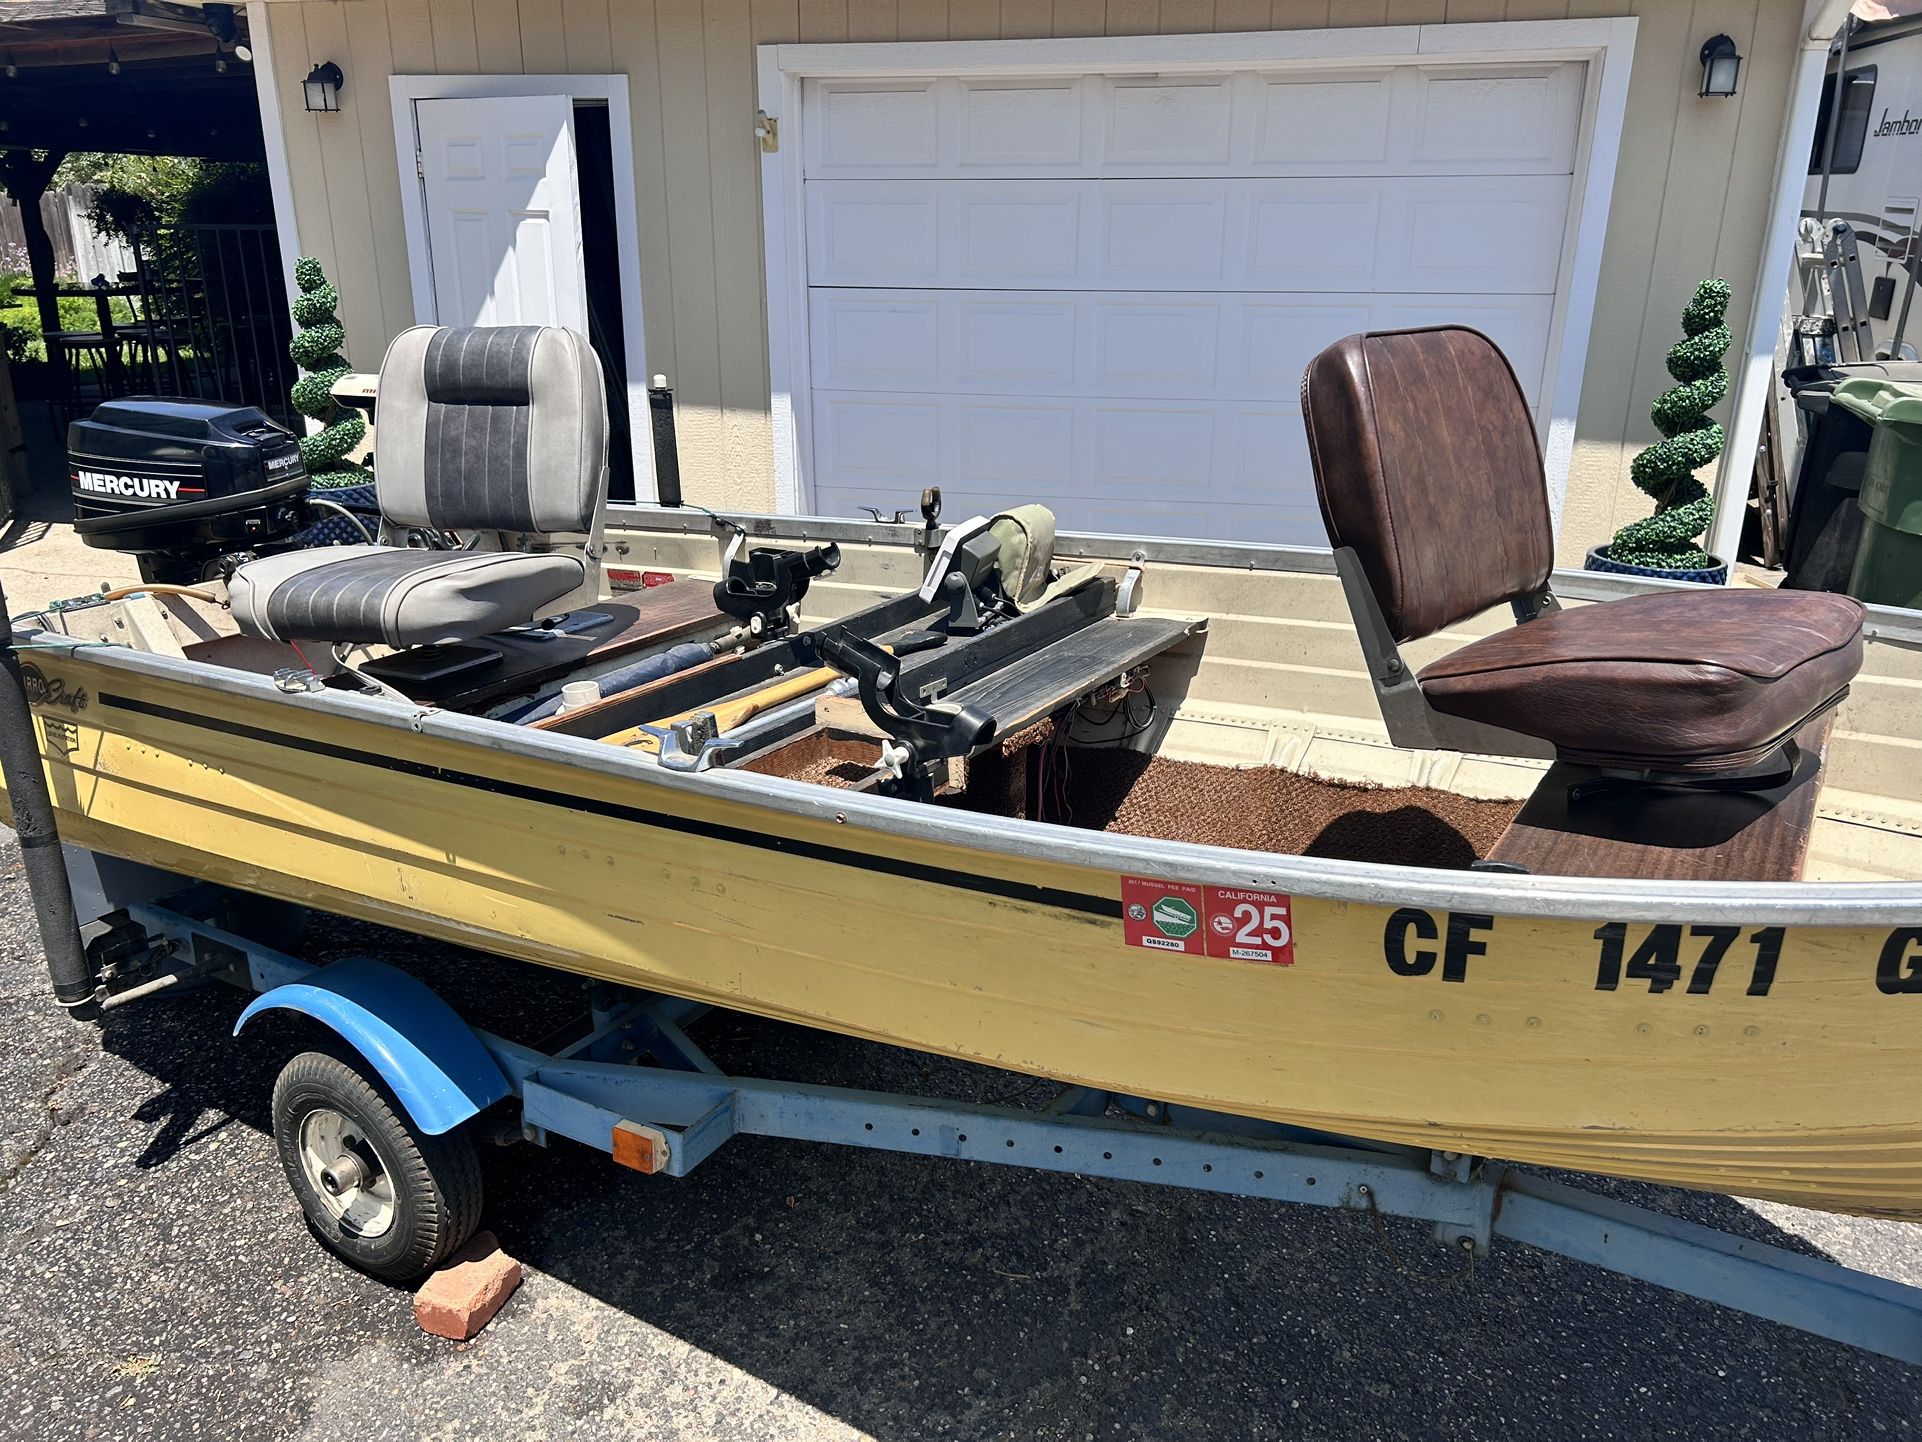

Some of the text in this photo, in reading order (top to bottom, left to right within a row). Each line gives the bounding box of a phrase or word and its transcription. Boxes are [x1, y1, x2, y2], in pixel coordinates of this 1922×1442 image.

[268, 453, 299, 470] MERCURY
[78, 470, 181, 499] MERCURY
[44, 679, 88, 713] Craft
[1141, 881, 1165, 889] MUSSEL
[1218, 890, 1277, 903] CALIFORNIA
[1233, 903, 1290, 947] 25
[1232, 949, 1268, 959] M-267504
[1384, 907, 1494, 983] CF
[1593, 921, 1786, 996] 1471
